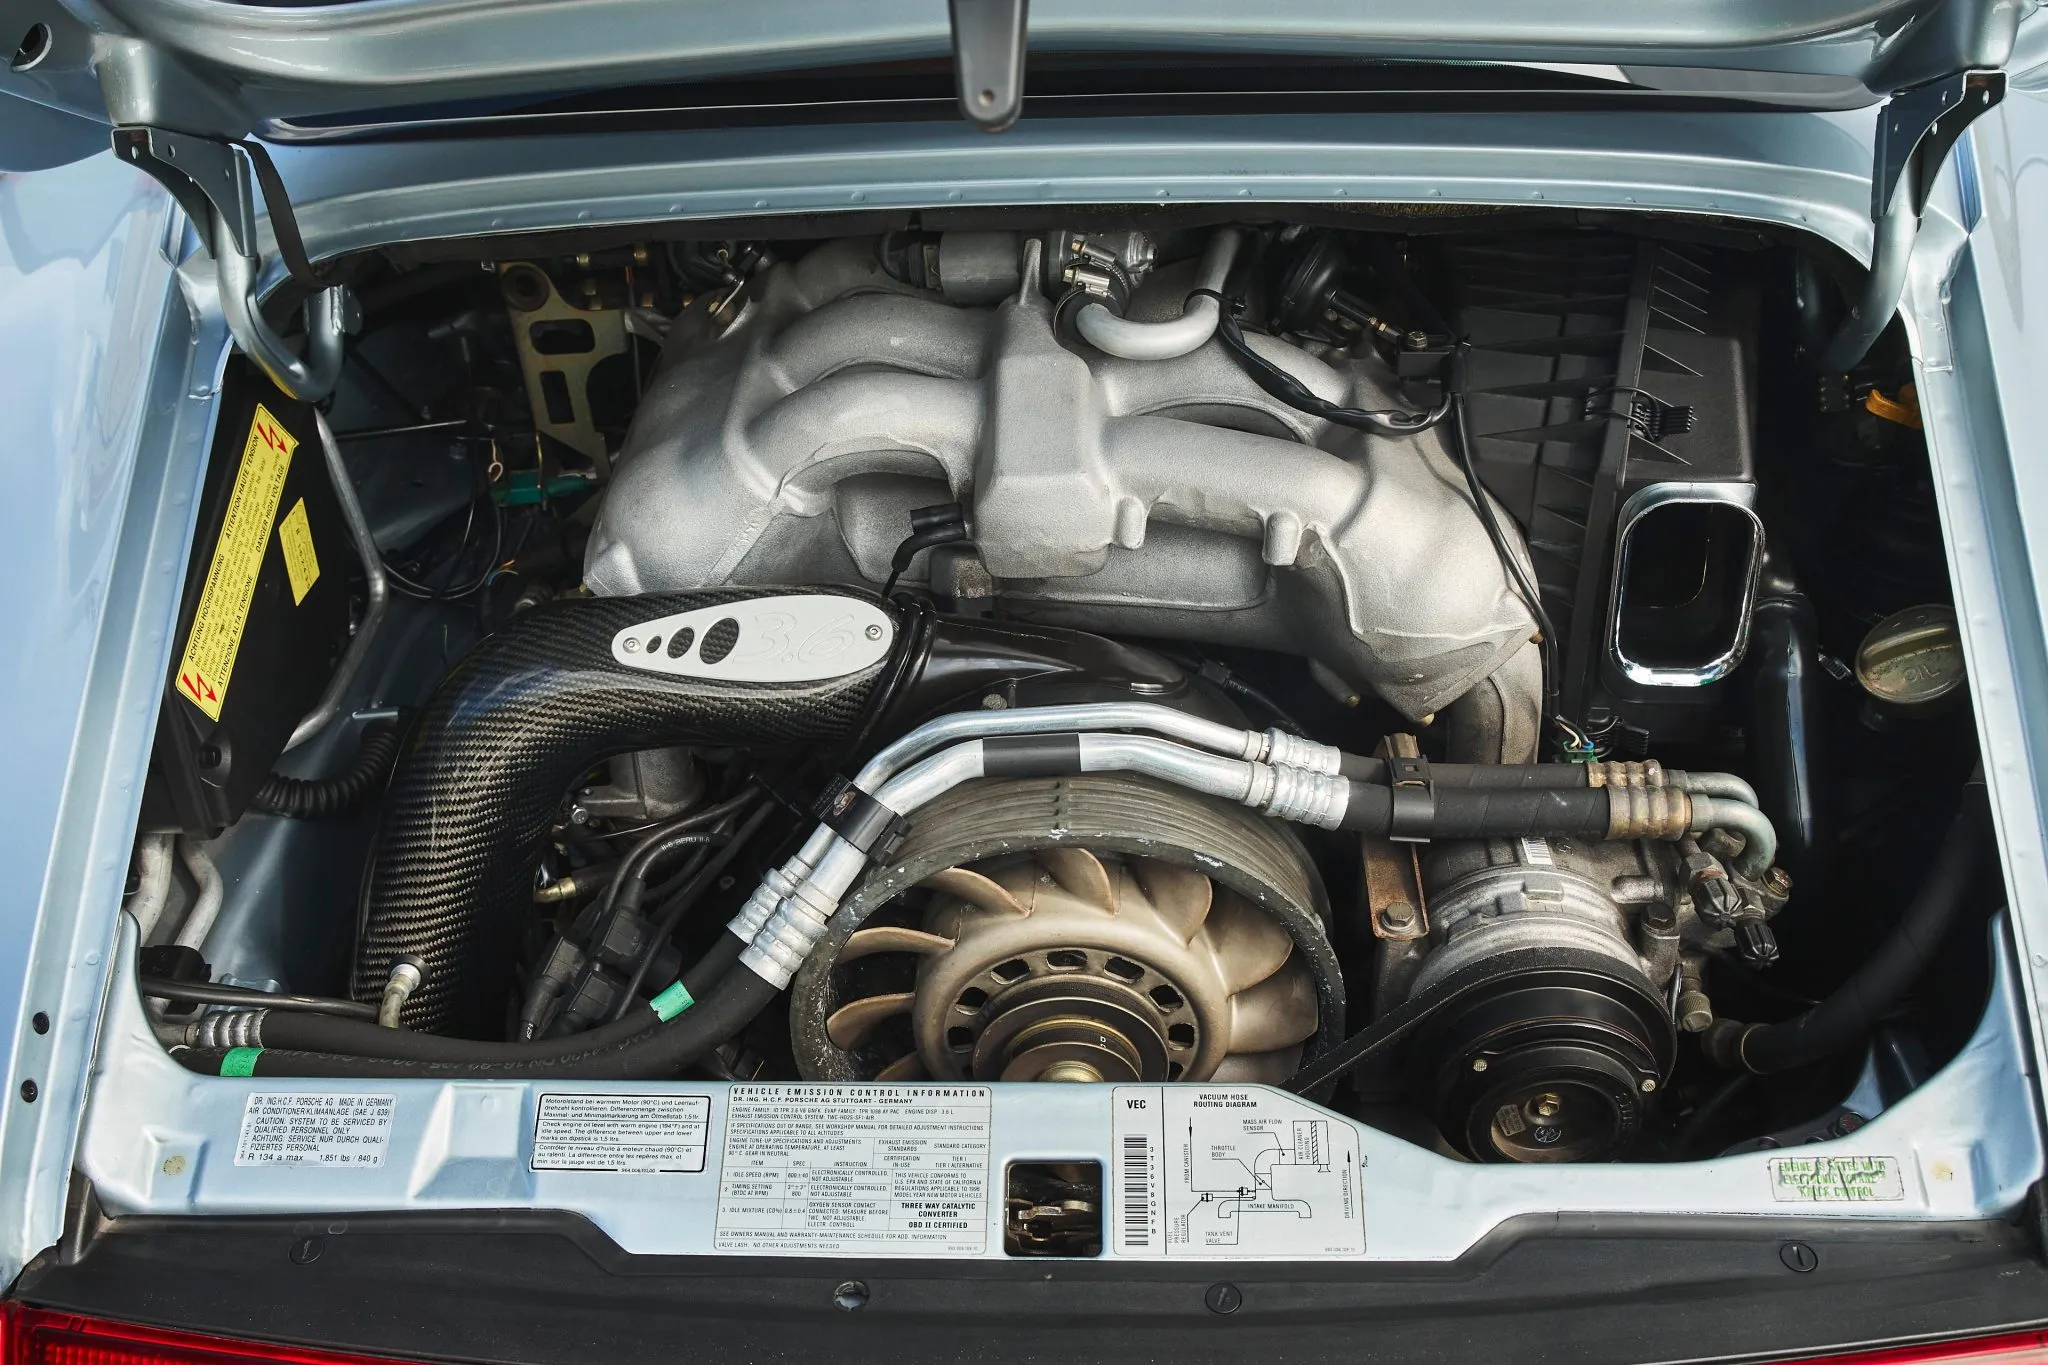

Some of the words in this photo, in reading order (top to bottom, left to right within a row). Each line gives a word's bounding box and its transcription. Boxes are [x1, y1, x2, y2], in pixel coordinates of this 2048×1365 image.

[225, 495, 242, 539] ATTENTION
[238, 467, 250, 495] HAUTE
[246, 434, 260, 467] TENSION
[256, 519, 269, 553] DANGER
[265, 498, 275, 519] HIGH
[271, 464, 285, 498] VOLTAGE
[189, 621, 204, 662] ACHTUNG
[201, 554, 224, 621] HOCHSPANNUNG
[217, 636, 236, 687] ATTENZIONE
[232, 614, 242, 636] ALTA
[238, 574, 254, 614] TENSIONE
[732, 612, 855, 663] 3.6
[1904, 666, 1940, 682] OIL
[787, 1088, 842, 1096] EMISSION
[850, 1089, 900, 1097] CONTROL
[254, 1096, 263, 1105] DR.
[296, 1097, 323, 1106] PORSCHE
[324, 1098, 333, 1106] AG
[339, 1098, 355, 1106] MADE
[357, 1098, 364, 1106] IN
[366, 1098, 393, 1106] GERMANY
[1127, 1100, 1146, 1109] VEC
[248, 1107, 259, 1115] AIR
[352, 1108, 367, 1116] (SAE
[331, 1118, 340, 1126] BE
[343, 1118, 376, 1126] SERVICED
[254, 1126, 287, 1134] QUALIFIED
[290, 1126, 329, 1134] PERSONNEL
[286, 1144, 320, 1152] PERSONAL
[373, 1156, 378, 1164] g
